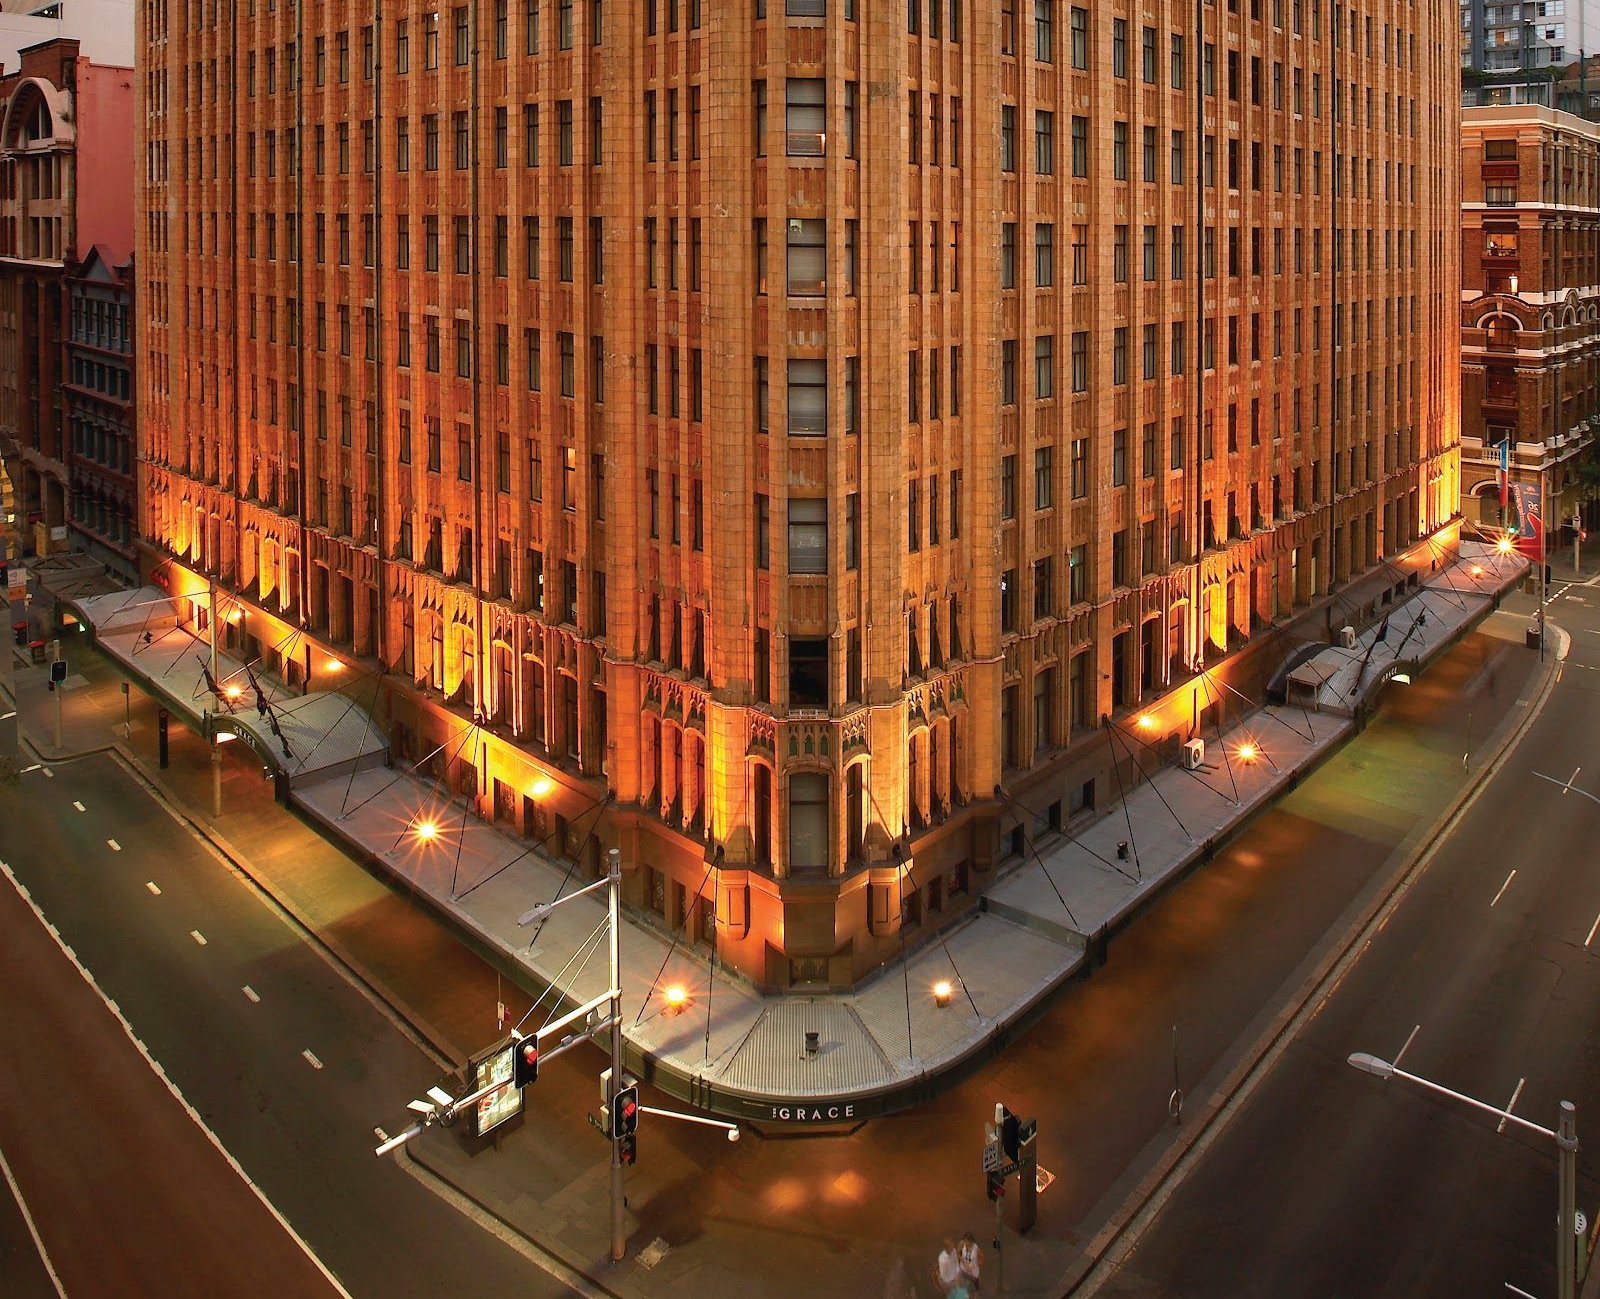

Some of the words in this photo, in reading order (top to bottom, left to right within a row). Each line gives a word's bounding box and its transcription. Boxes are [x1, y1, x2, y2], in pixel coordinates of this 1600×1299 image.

[779, 1105, 854, 1120] GRACE
[984, 1144, 996, 1155] ONE
[984, 1153, 996, 1164] WAY
